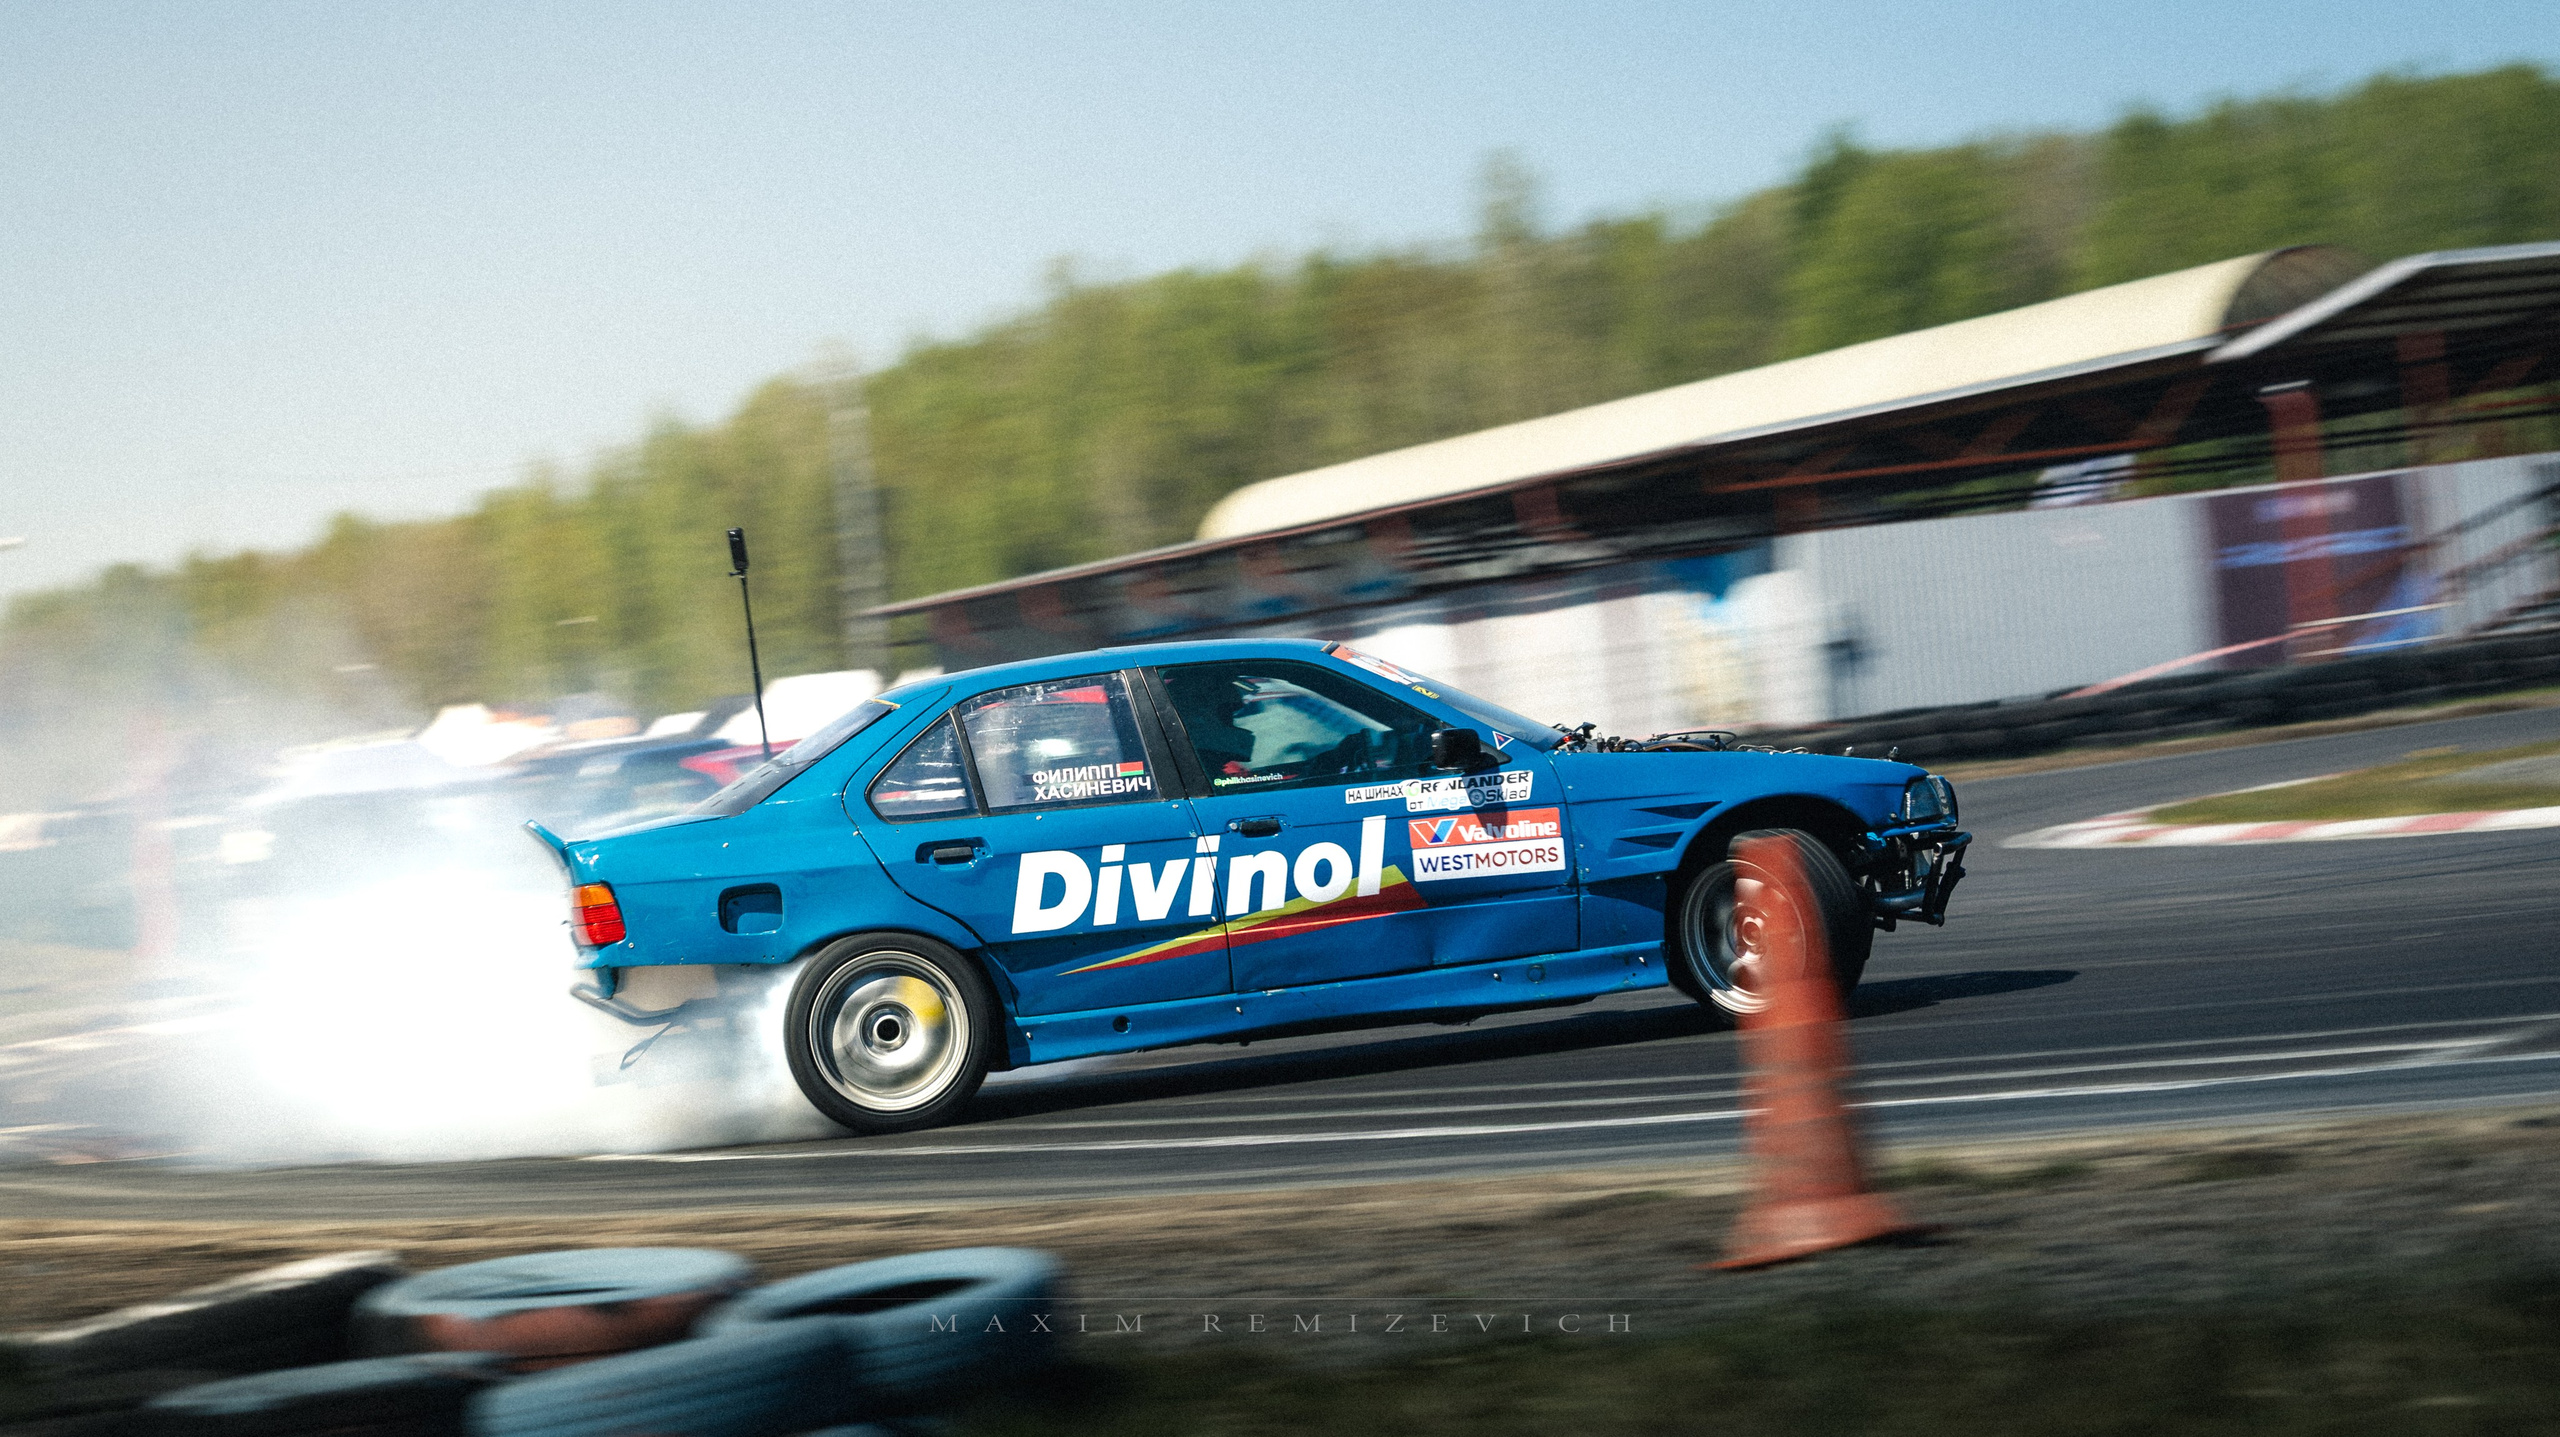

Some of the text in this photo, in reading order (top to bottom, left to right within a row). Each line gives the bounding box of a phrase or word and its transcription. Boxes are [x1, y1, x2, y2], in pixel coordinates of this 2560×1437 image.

[1032, 763, 1114, 785] ФИЛИПП
[1033, 776, 1152, 801] ХАСИНЕВИЧ
[1348, 790, 1362, 802] НА
[1365, 785, 1404, 800] ШИНАХ
[1485, 785, 1528, 802] Sklad
[1457, 820, 1558, 843] Valvoline
[1419, 846, 1559, 874] WESTMOTORS
[1011, 815, 1387, 935] Divinol
